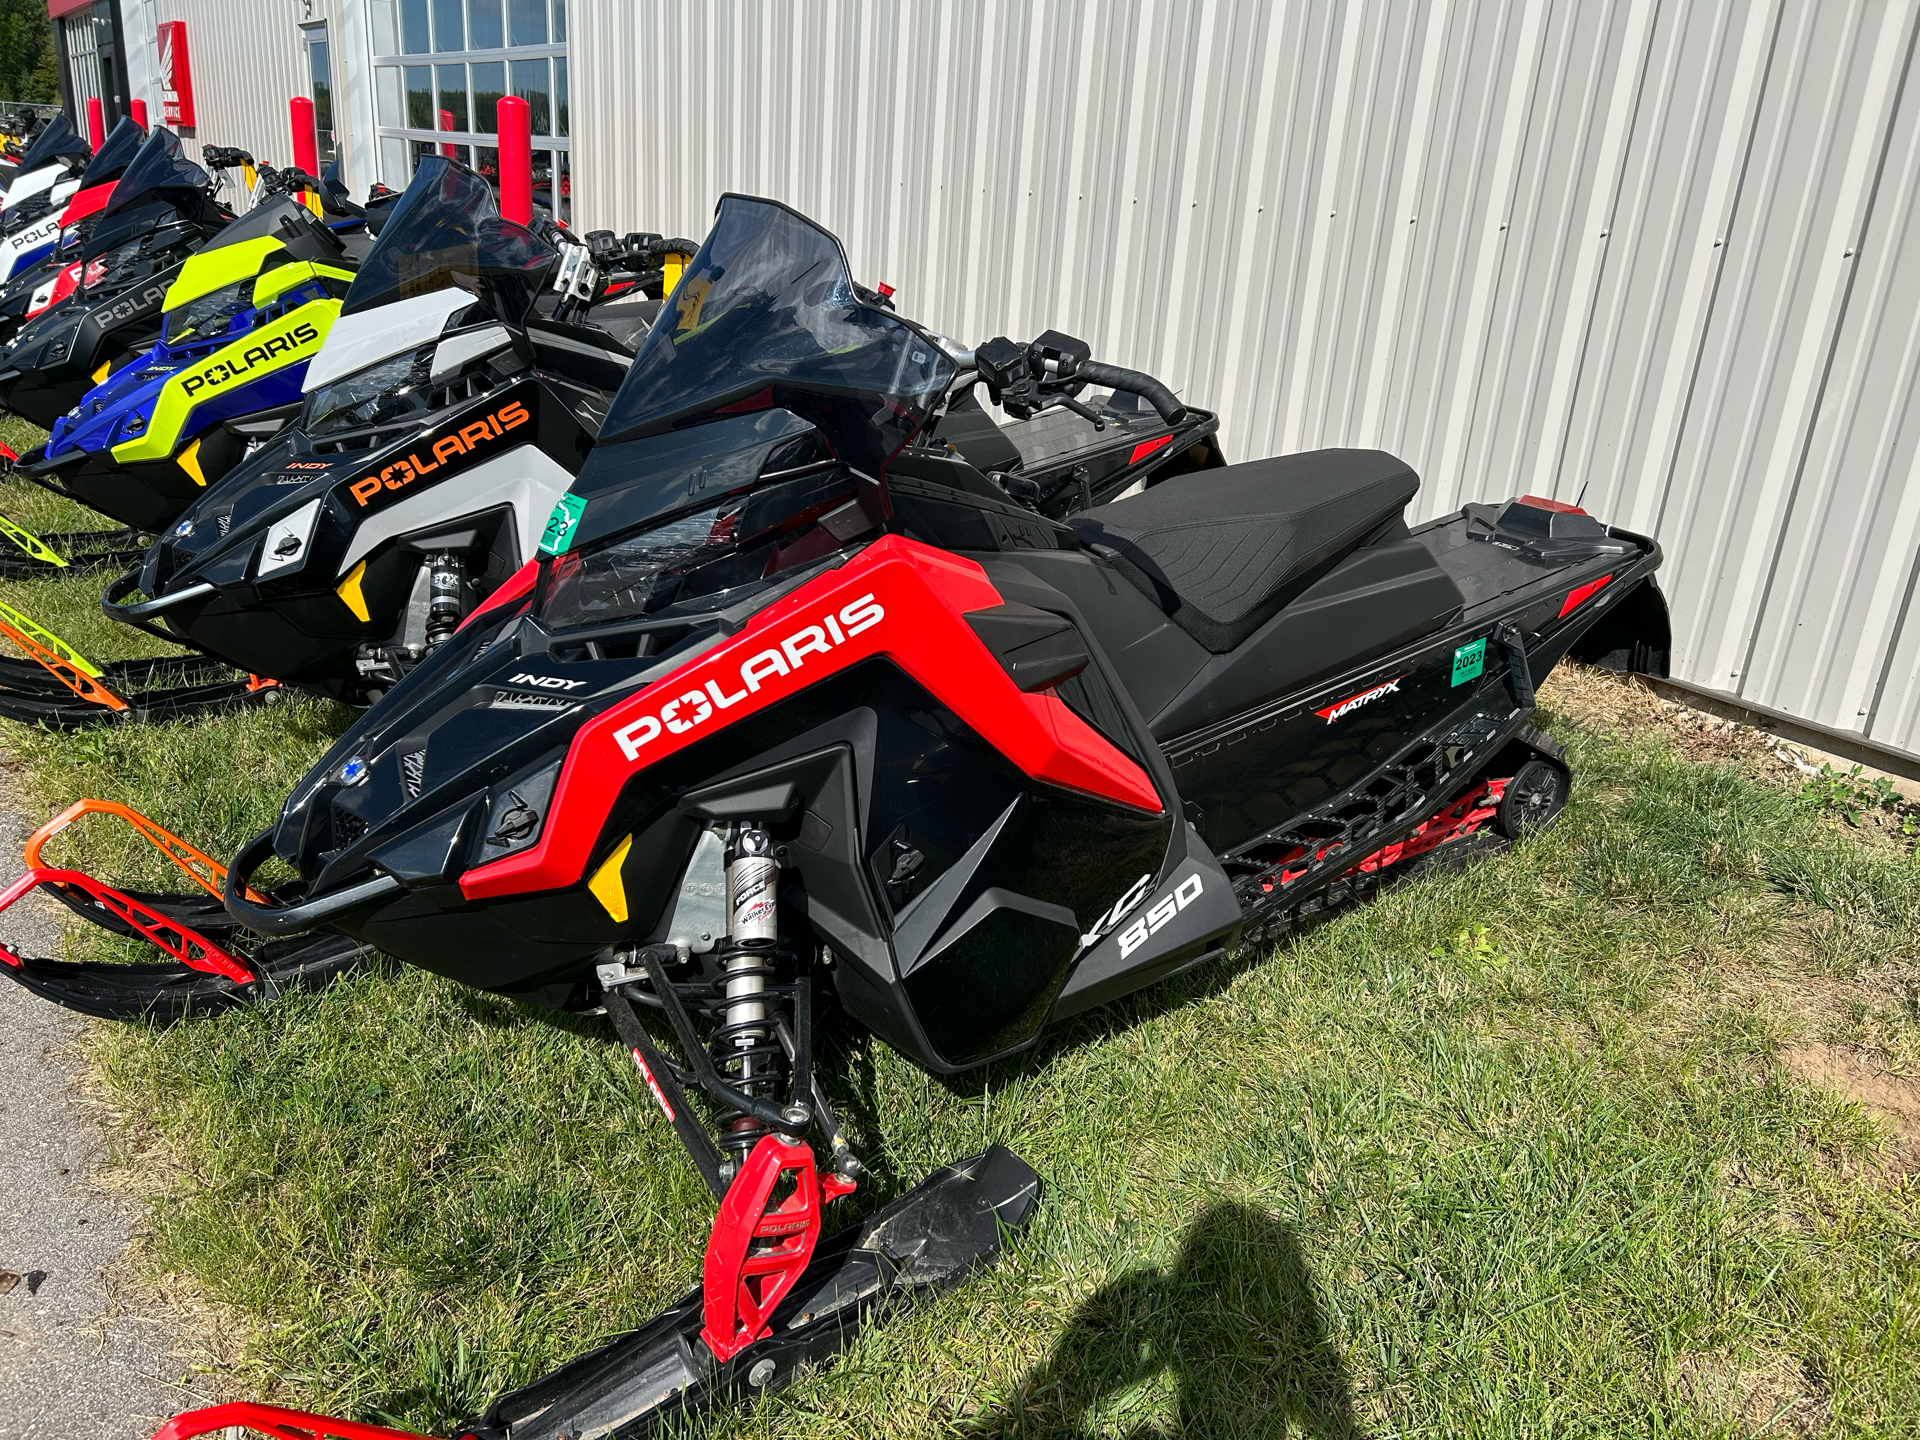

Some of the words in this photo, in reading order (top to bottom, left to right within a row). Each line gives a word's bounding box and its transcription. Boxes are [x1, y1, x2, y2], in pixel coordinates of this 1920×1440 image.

[11, 221, 60, 249] POLA
[181, 322, 319, 397] POLARIS
[285, 462, 336, 470] INDY
[350, 401, 530, 507] POLARIS
[433, 572, 459, 588] FOX
[1455, 650, 1483, 671] 2023
[507, 672, 588, 690] INDY
[612, 592, 885, 762] POLARIS
[1326, 678, 1400, 725] MATRYX
[735, 881, 766, 906] FORCE
[1117, 872, 1204, 961] 850
[760, 1219, 811, 1234] POLARIS
